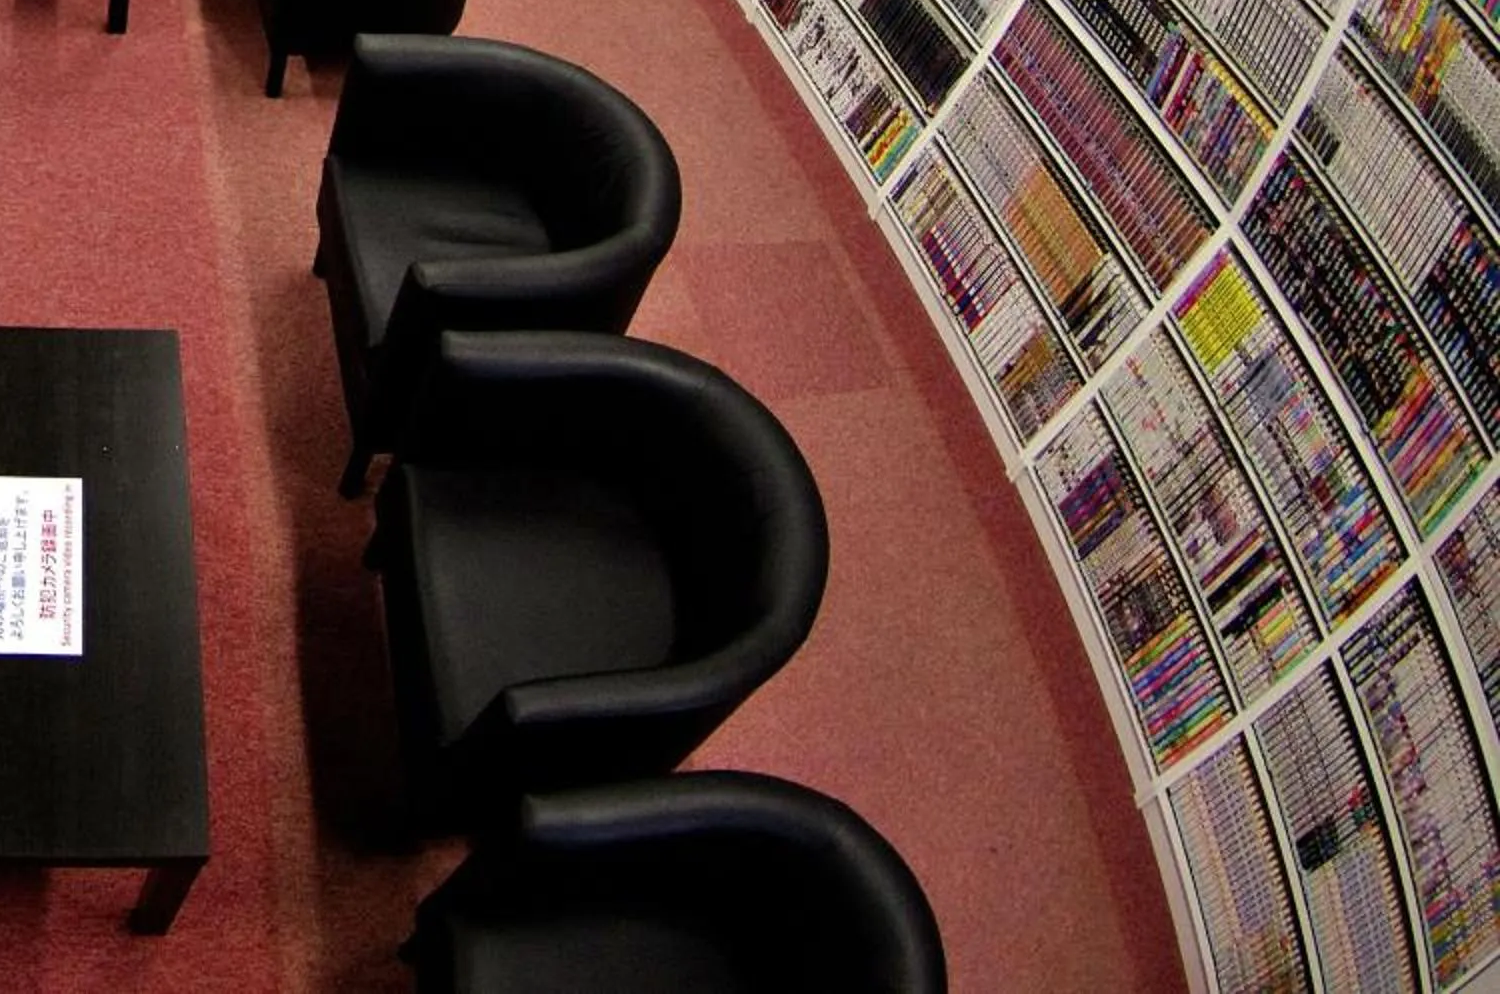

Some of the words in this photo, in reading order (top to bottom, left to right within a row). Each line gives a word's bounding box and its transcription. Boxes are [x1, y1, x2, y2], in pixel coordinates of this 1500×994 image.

[62, 495, 75, 539] recording
[39, 509, 57, 619] 防犯カメラ録画中
[62, 542, 73, 567] video
[63, 569, 73, 605] camera
[61, 607, 74, 646] Security
